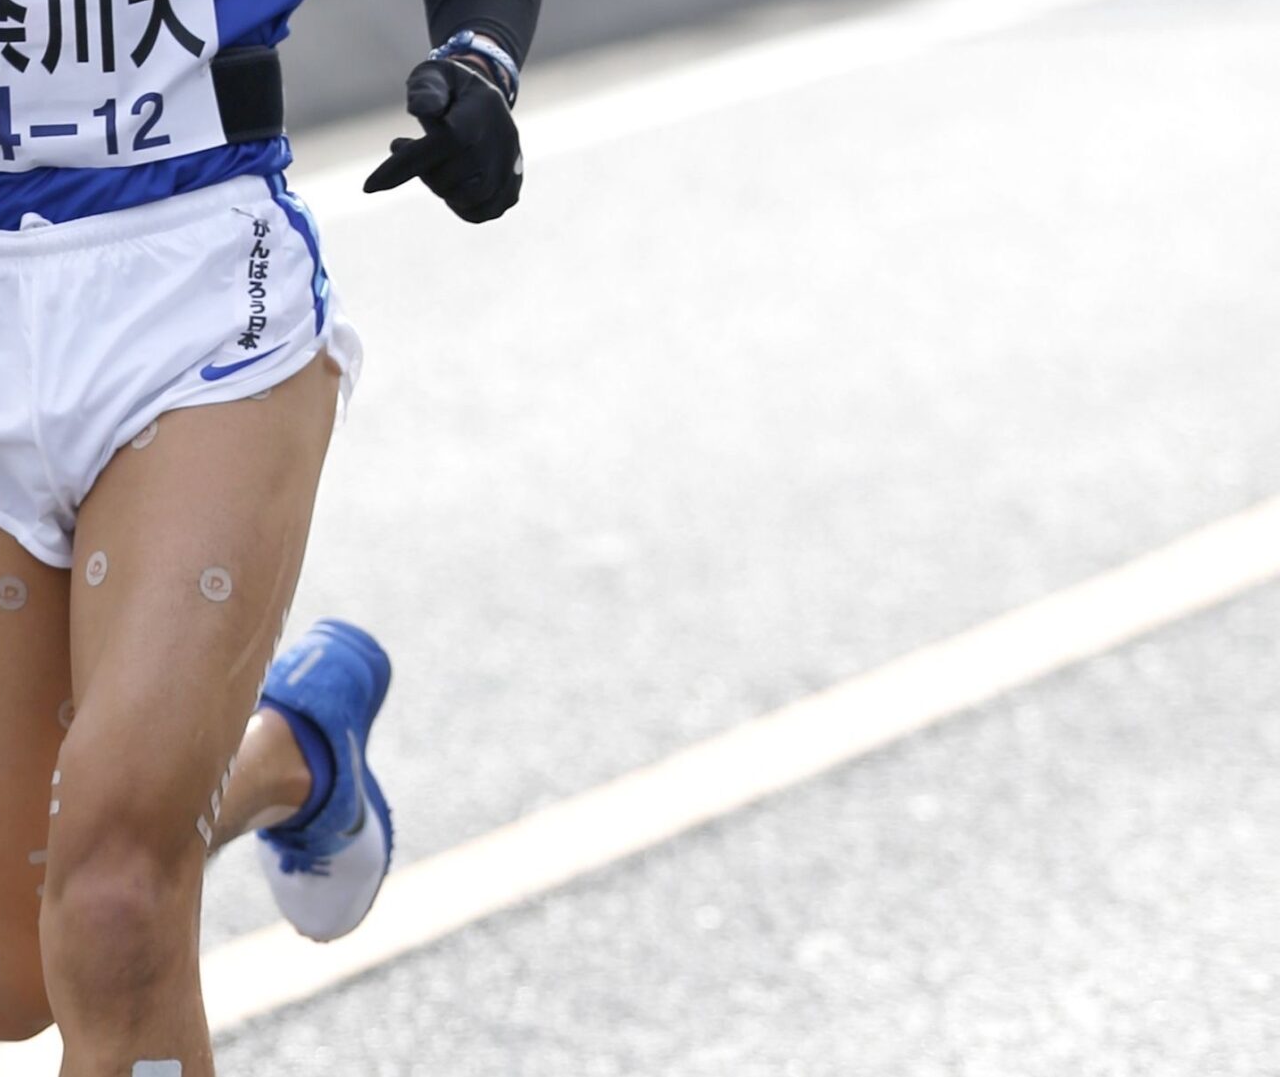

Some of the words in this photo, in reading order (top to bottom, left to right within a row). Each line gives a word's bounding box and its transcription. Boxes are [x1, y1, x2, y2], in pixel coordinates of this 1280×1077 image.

[238, 220, 271, 350] がんばろう日本
